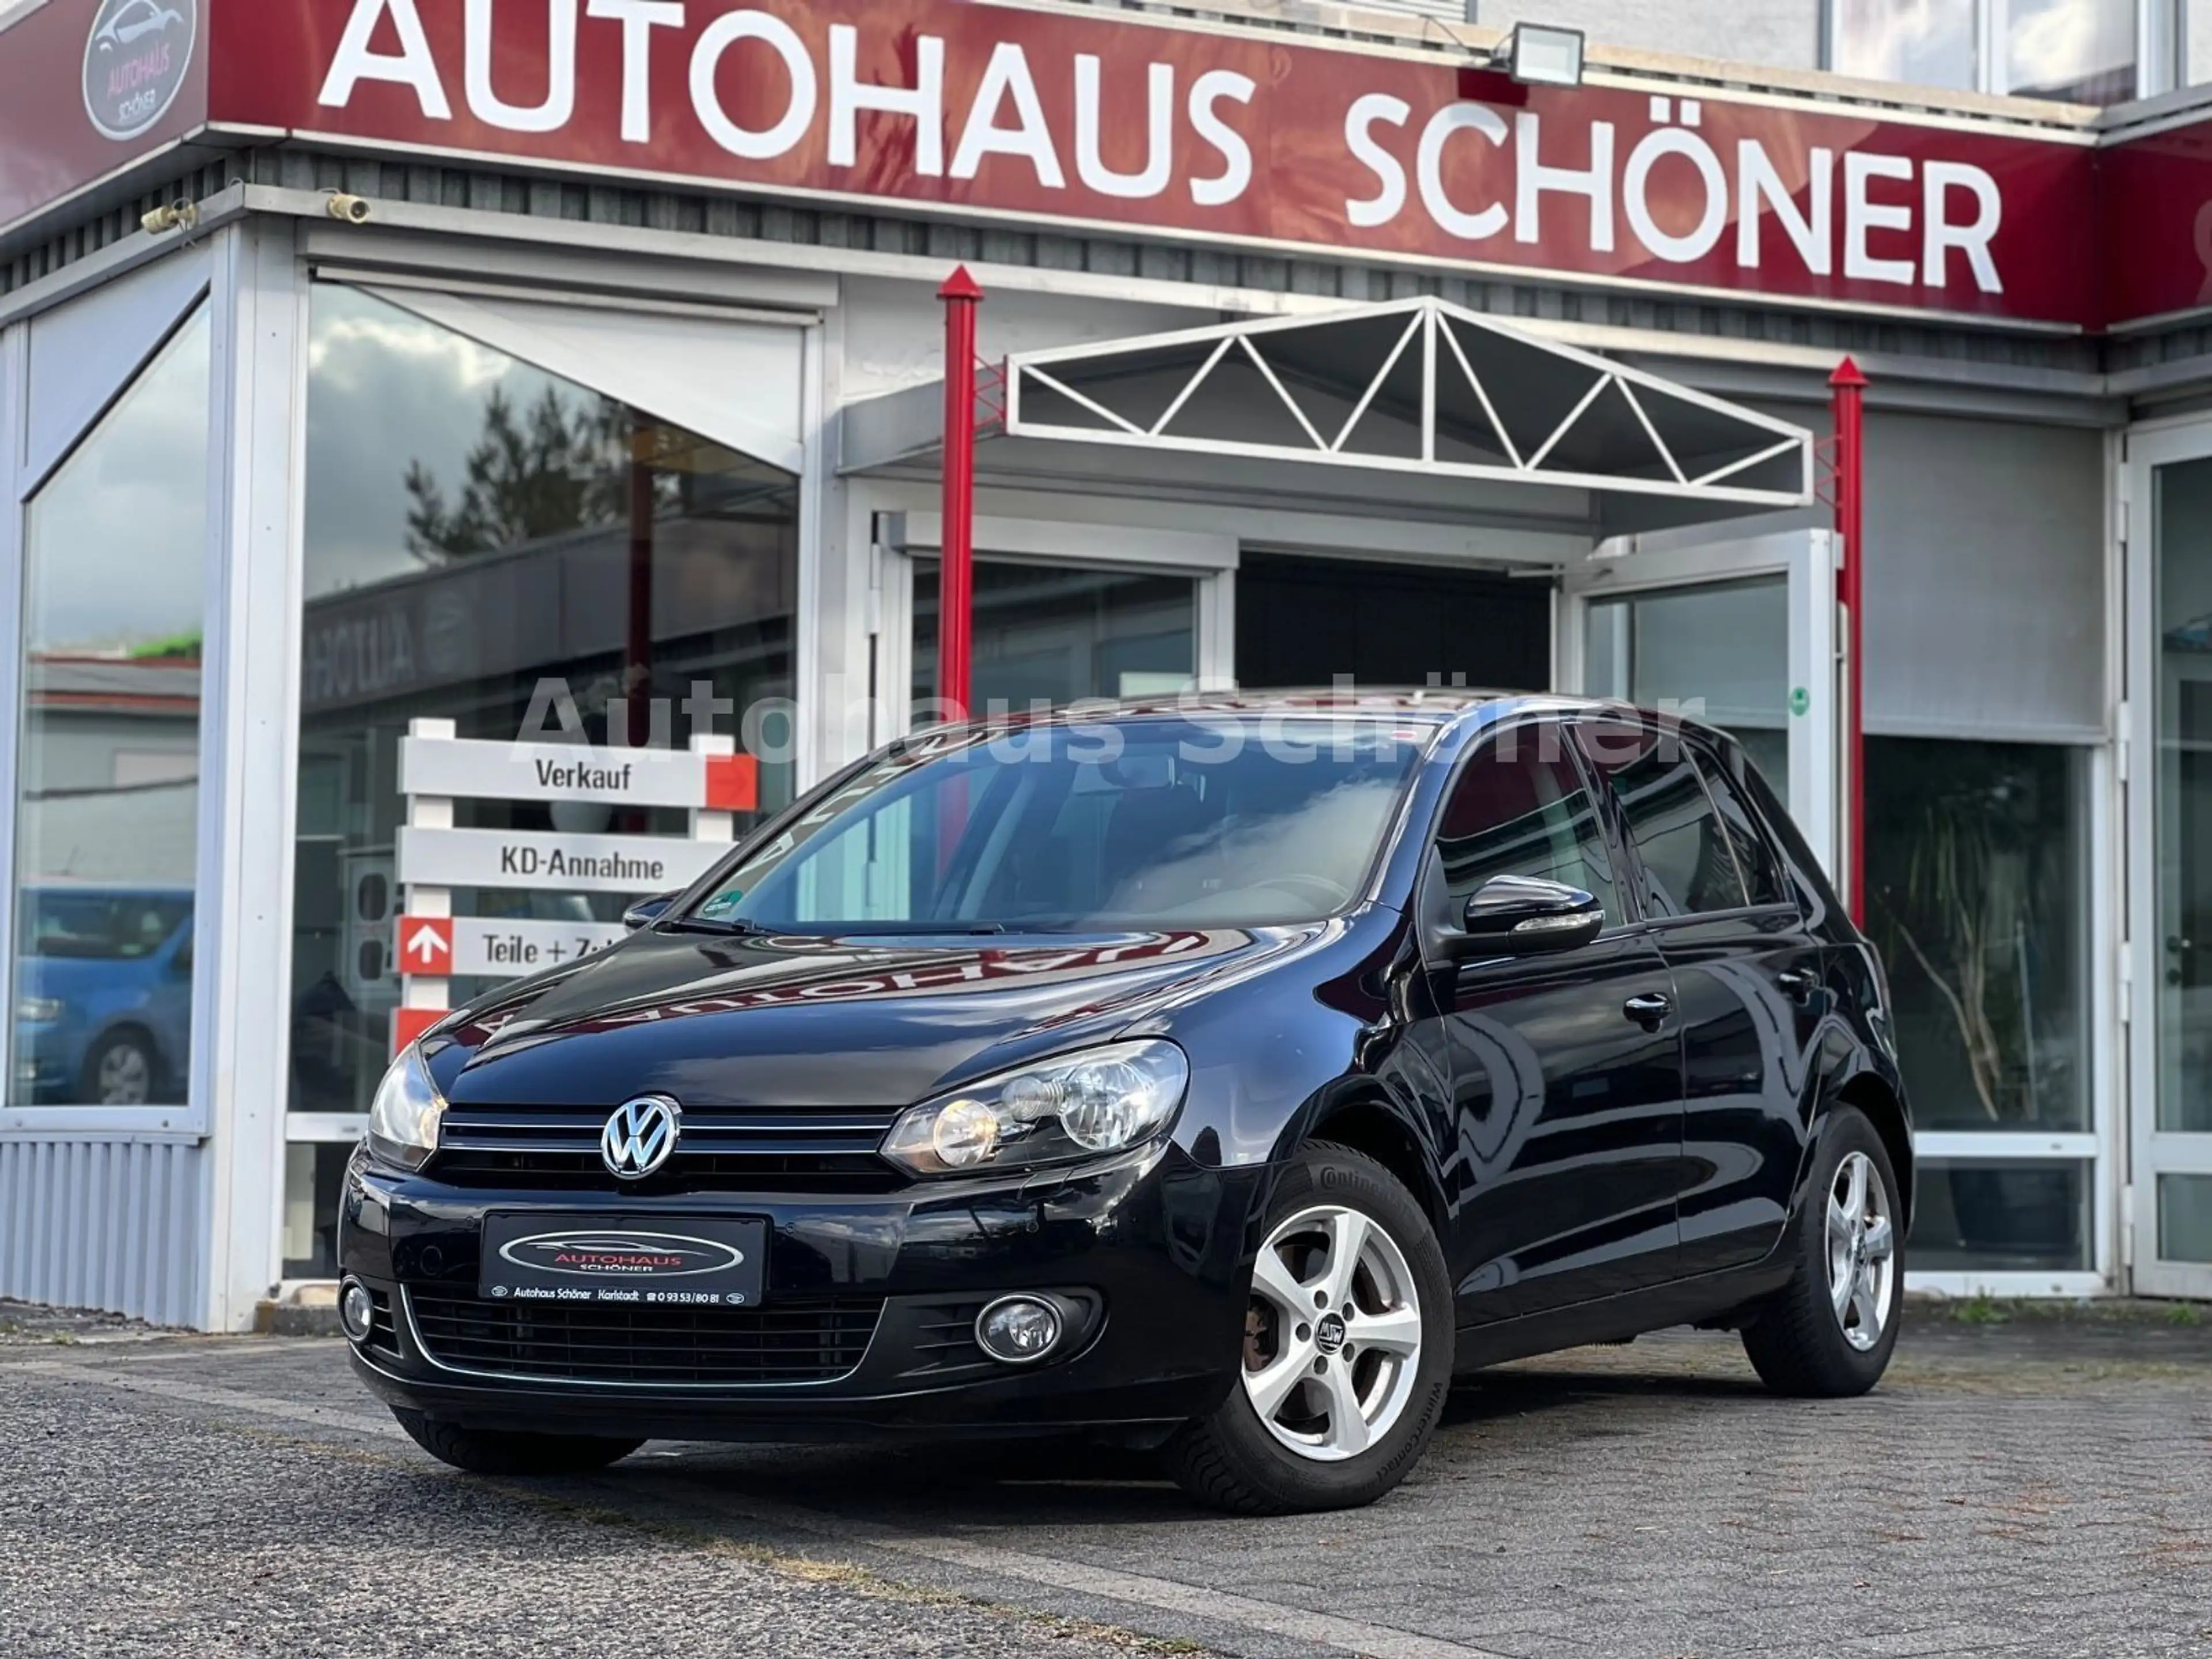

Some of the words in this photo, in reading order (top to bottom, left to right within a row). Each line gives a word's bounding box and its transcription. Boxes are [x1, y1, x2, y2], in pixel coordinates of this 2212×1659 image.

[108, 40, 170, 100] AUTOHAUS
[119, 88, 156, 122] SCHÖNER
[318, 0, 1257, 206] AUTOHAUS
[1344, 93, 2003, 293] SCHÖNER
[536, 758, 632, 791] Verkauf
[501, 845, 664, 880] KD-Annahme
[482, 933, 539, 964] Teile
[555, 1253, 682, 1266] AUTOHAUS
[580, 1263, 653, 1272] SCHÖNER
[514, 1287, 555, 1298] Autohaus
[556, 1288, 592, 1300] Schöner
[598, 1289, 639, 1301] Karlstadt
